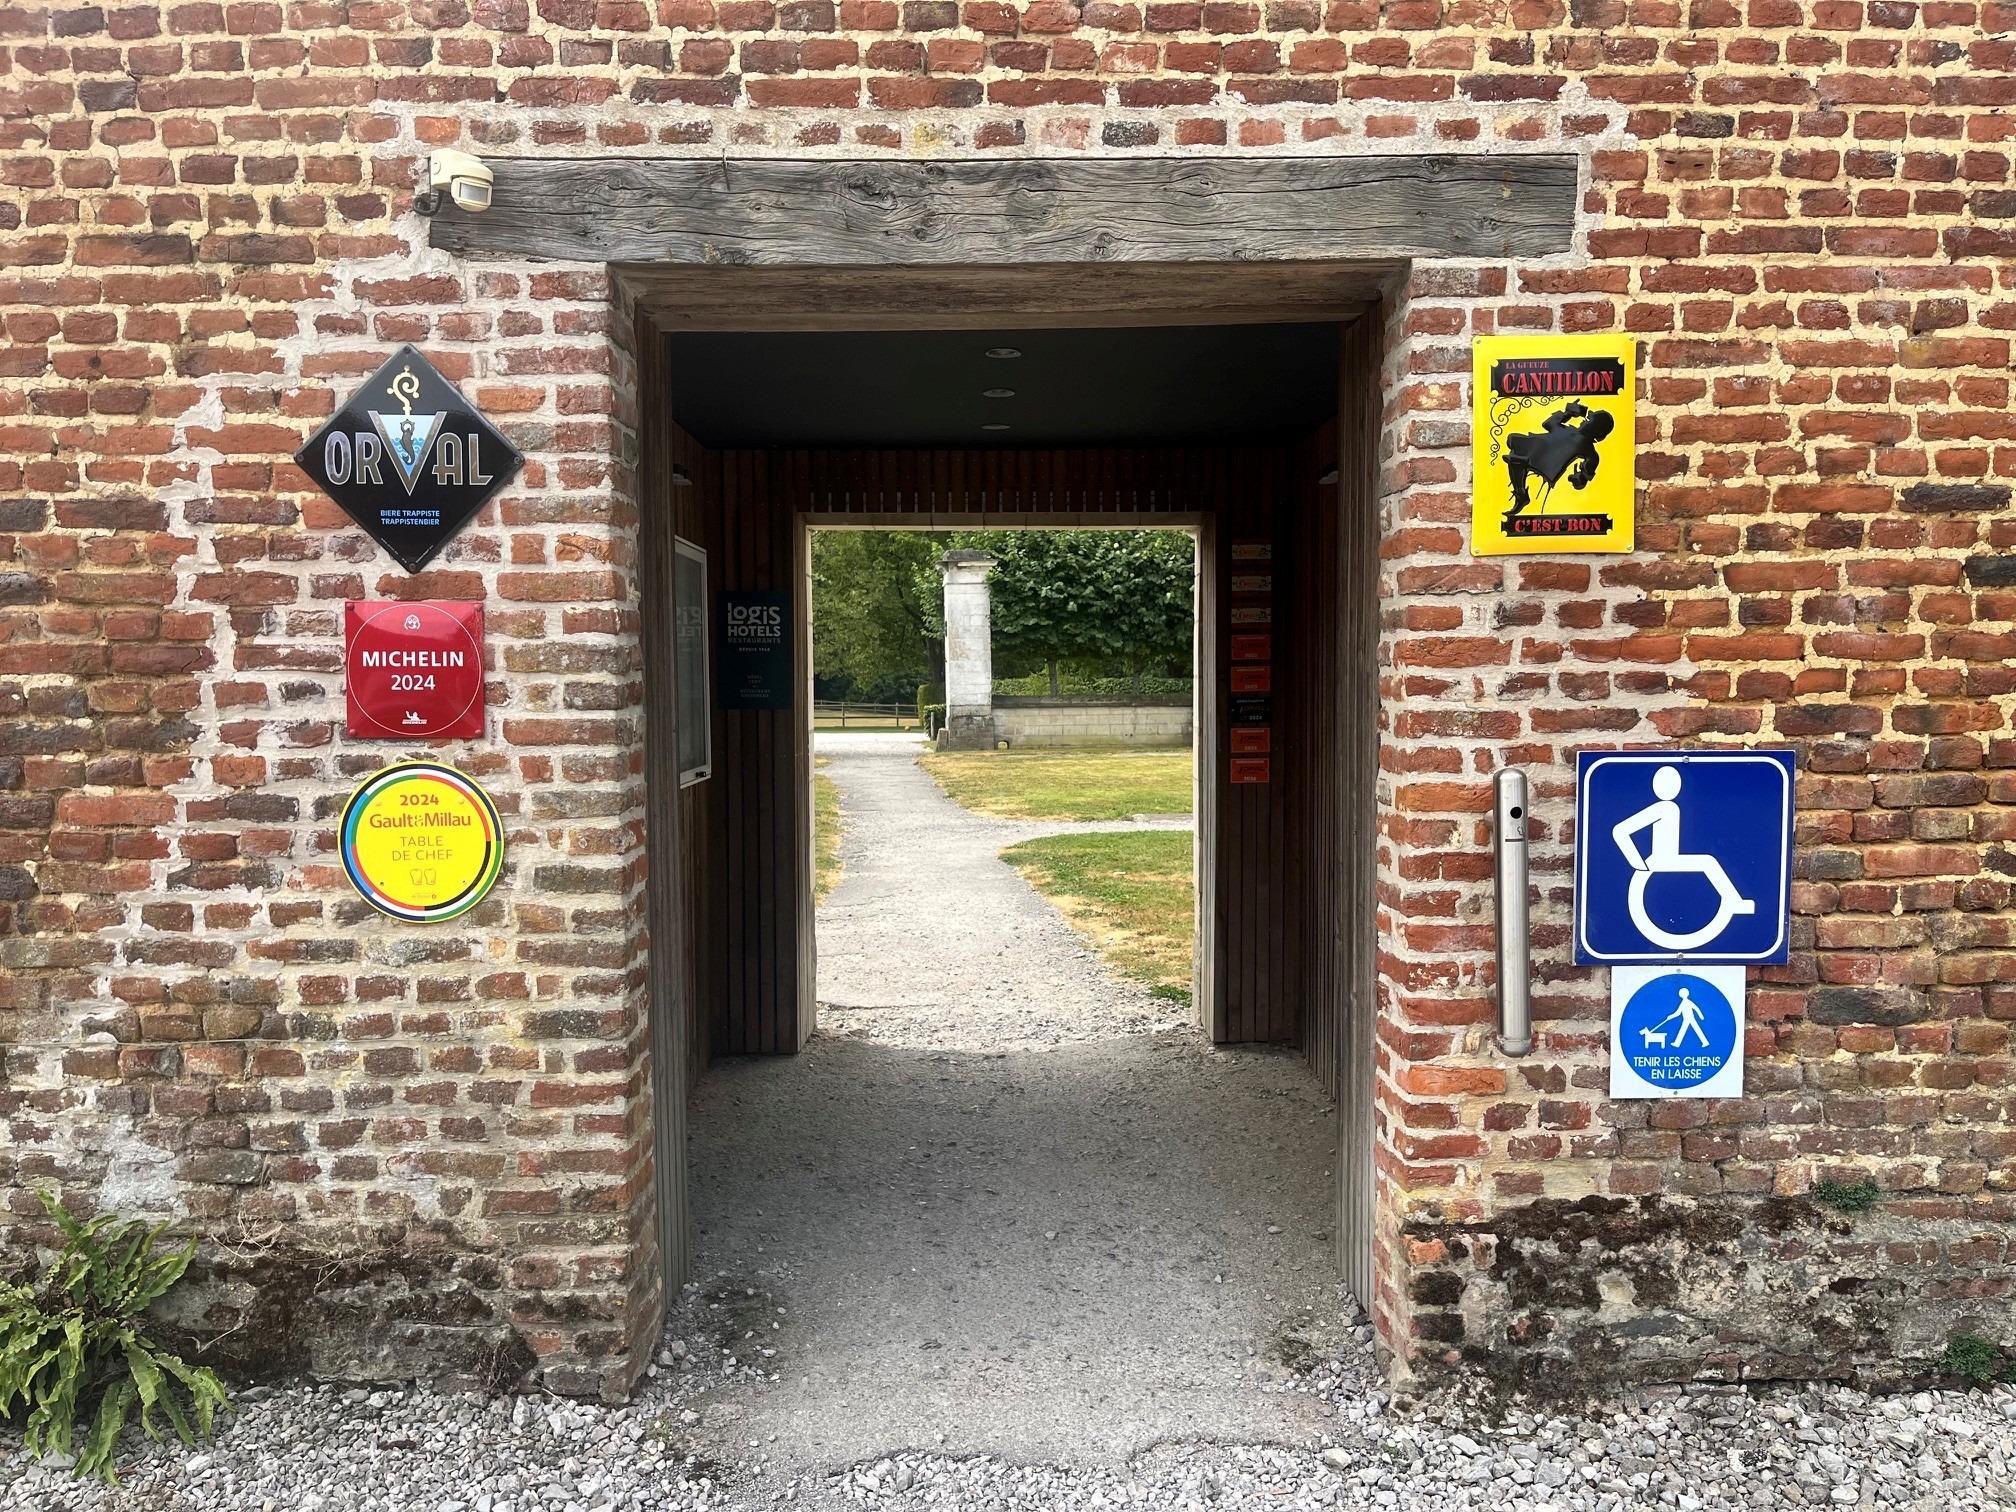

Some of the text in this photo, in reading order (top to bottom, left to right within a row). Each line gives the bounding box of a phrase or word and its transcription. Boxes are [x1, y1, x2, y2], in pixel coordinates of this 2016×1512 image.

[1505, 361, 1549, 369] LA GUEUZE
[1503, 370, 1615, 394] CANTILLON
[324, 410, 494, 496] ORVAL
[402, 509, 440, 517] TRAPPISTE
[381, 518, 440, 526] TRAPPISTENBIER
[1514, 518, 1601, 533] C'EST BON
[728, 626, 781, 637] HOTELS
[362, 651, 464, 667] MICHELIN
[391, 674, 436, 691] 2024
[399, 794, 440, 806] 2024
[400, 835, 444, 847] TABLE
[392, 849, 453, 861] DE CHEF
[1633, 1056, 1721, 1067] TENIR LES CHIENS
[1651, 1069, 1702, 1079] EN LAISSE
